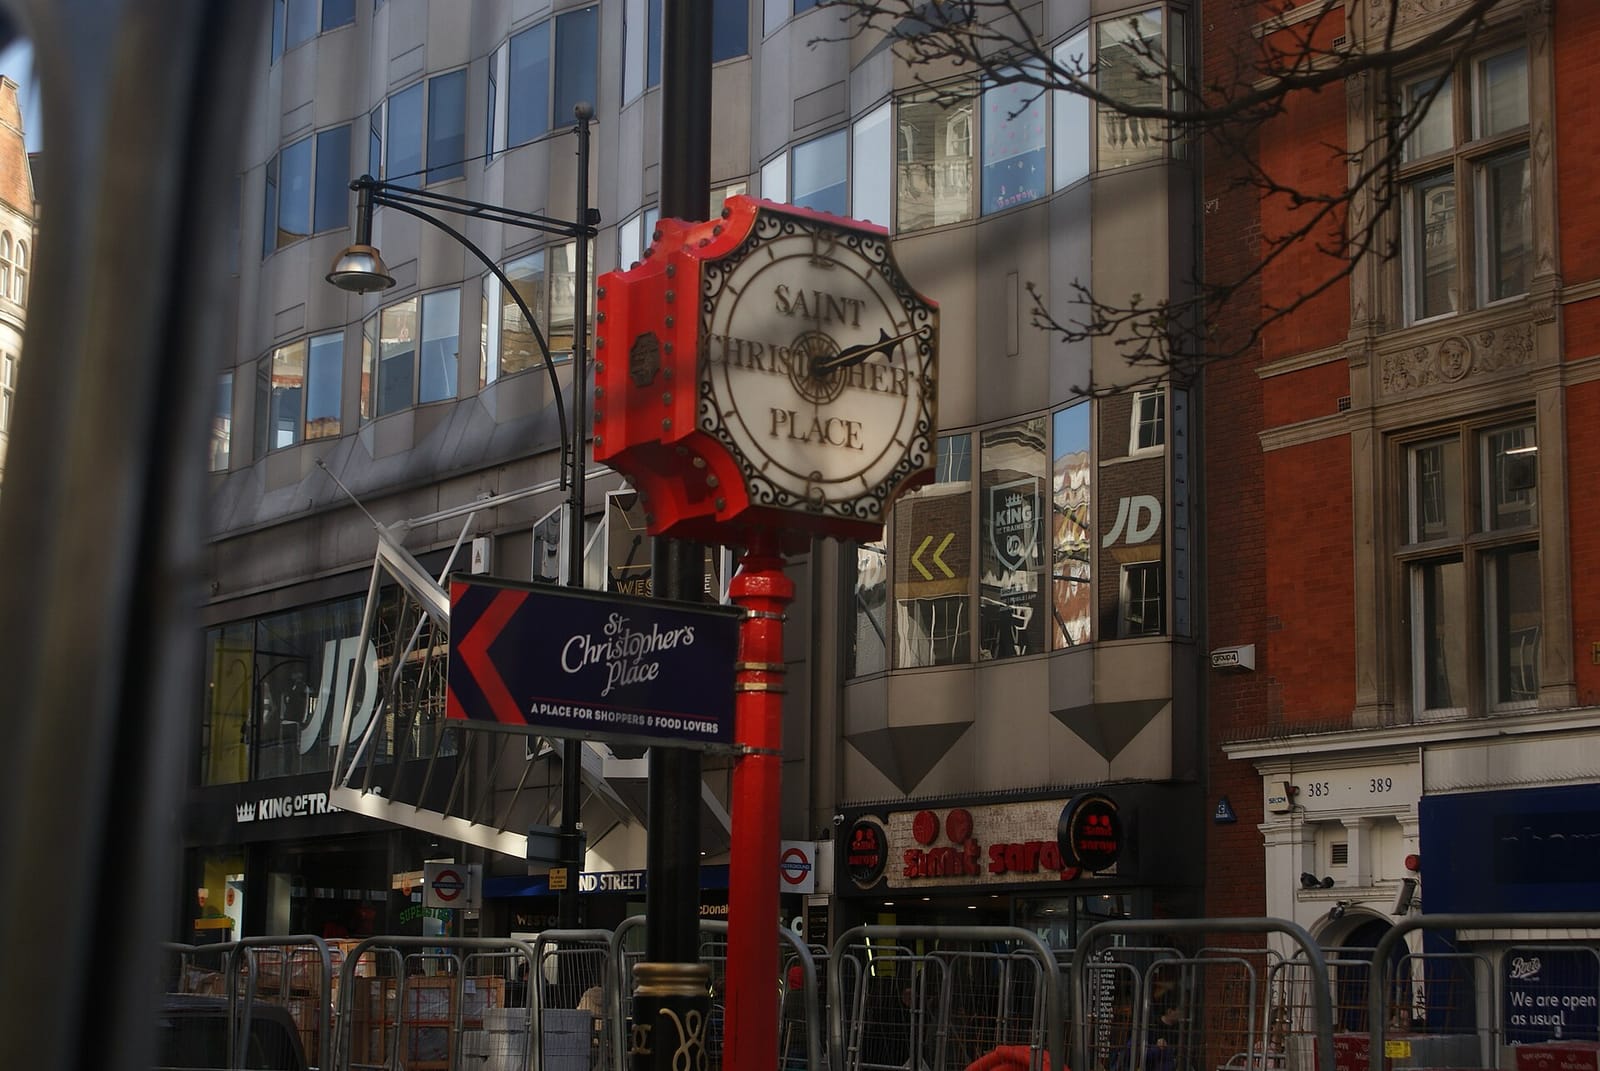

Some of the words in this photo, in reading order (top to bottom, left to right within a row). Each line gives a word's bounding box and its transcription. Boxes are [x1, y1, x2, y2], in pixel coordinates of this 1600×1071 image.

[775, 284, 864, 327] SAINT
[770, 407, 863, 450] PLACE
[996, 506, 1032, 526] KING
[1102, 495, 1162, 548] JD
[617, 580, 656, 599] WES
[604, 612, 630, 636] St
[561, 623, 695, 674] Christopher's
[300, 635, 379, 755] JD
[531, 703, 539, 714] A
[540, 704, 571, 717] PLACE
[573, 708, 593, 720] FOR
[594, 711, 645, 726] SHOPPERS
[655, 717, 682, 729] FOOD
[683, 720, 719, 734] LOVERS
[1308, 782, 1330, 797] 385
[1369, 777, 1392, 793] 389
[258, 796, 293, 820] KING
[579, 872, 598, 892] ND
[600, 872, 642, 892] STREET
[698, 904, 729, 915] cDonal
[1509, 957, 1541, 979] Boots
[1510, 991, 1533, 1007] We
[1536, 995, 1559, 1007] are
[1562, 995, 1597, 1011] open
[1511, 1014, 1527, 1026] as
[1530, 1009, 1566, 1027] usual
